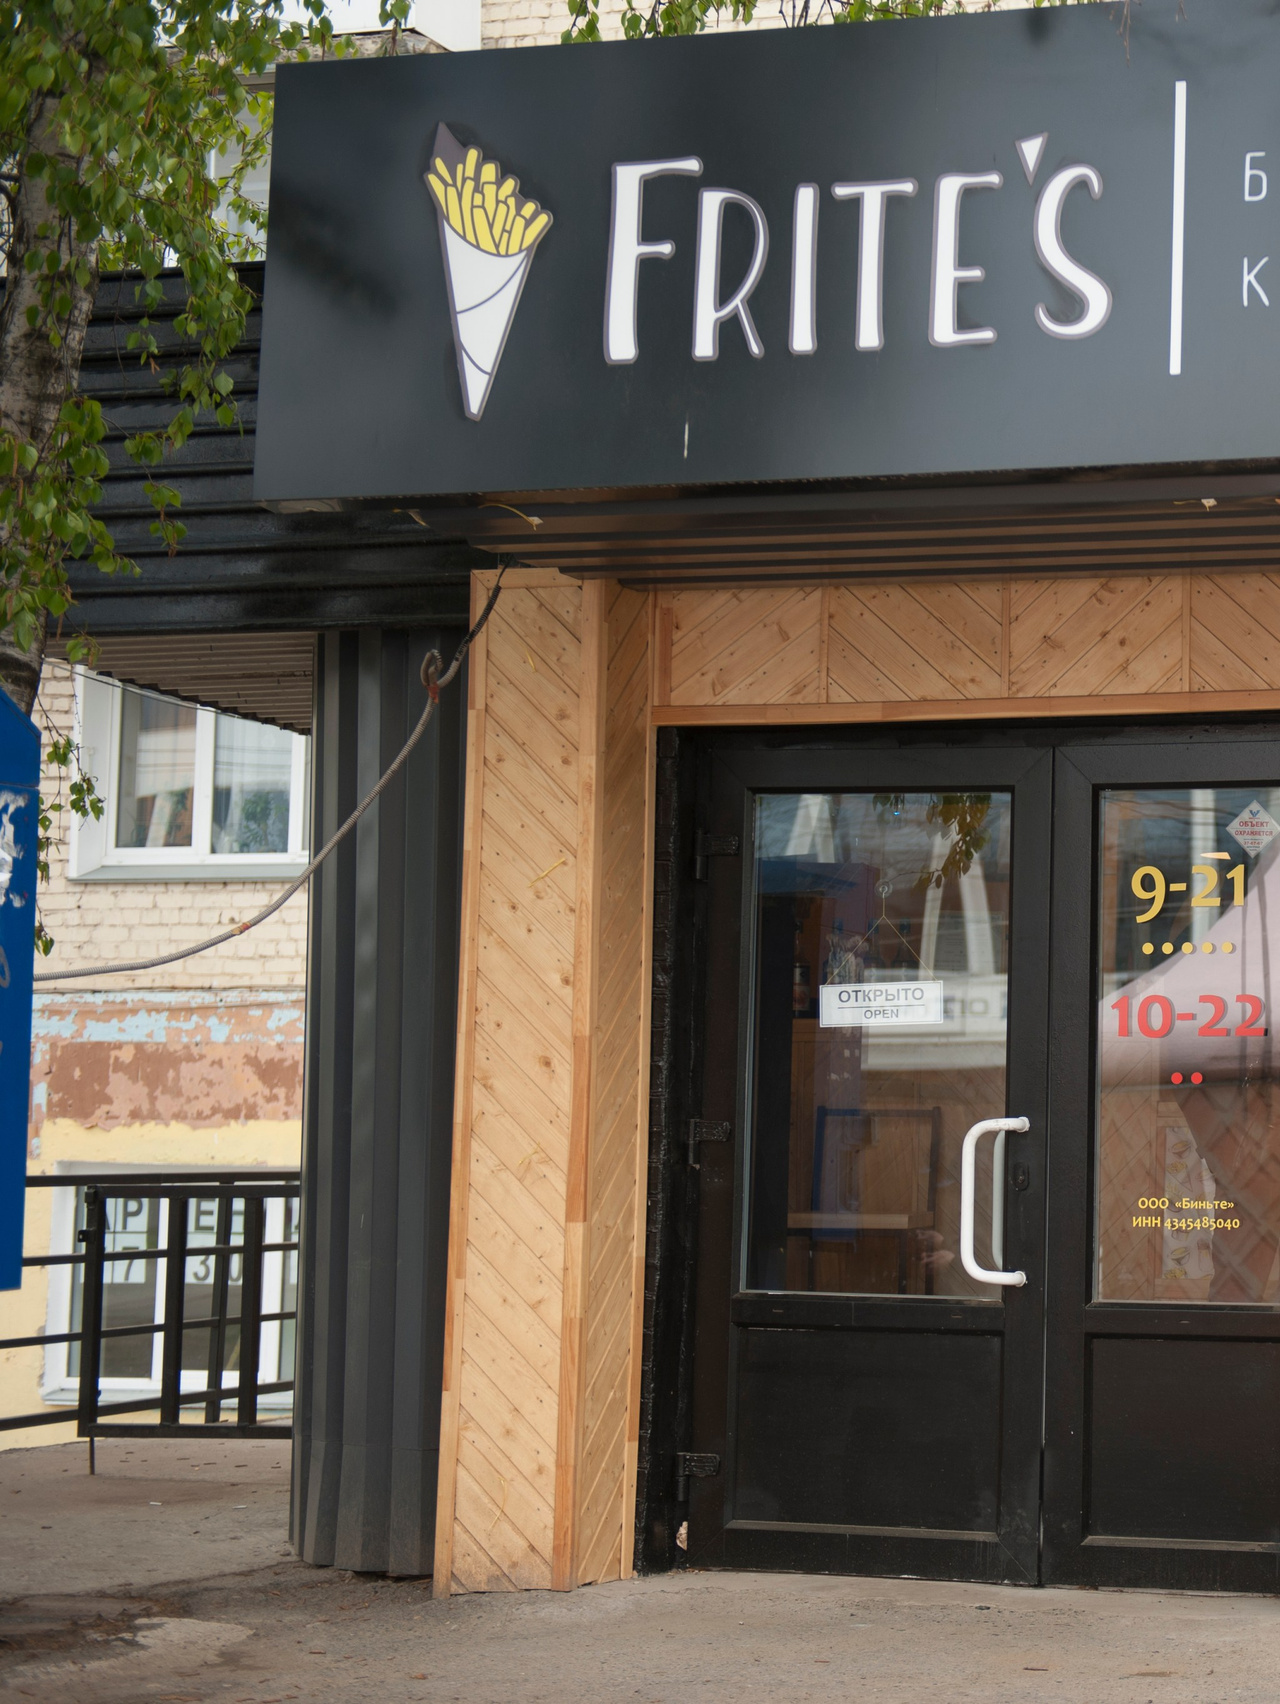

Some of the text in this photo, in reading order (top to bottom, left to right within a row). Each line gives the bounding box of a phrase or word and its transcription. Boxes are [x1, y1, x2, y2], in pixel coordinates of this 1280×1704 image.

[603, 132, 1112, 364] FRITE'S
[1131, 864, 1245, 924] 9-21
[838, 987, 925, 1004] ОТКРЫТО
[864, 1008, 899, 1020] OPEN
[1110, 994, 1268, 1039] 10-22
[1138, 1197, 1235, 1210] ООО «Биньте»
[1132, 1216, 1240, 1231] ИНН 4345485040
